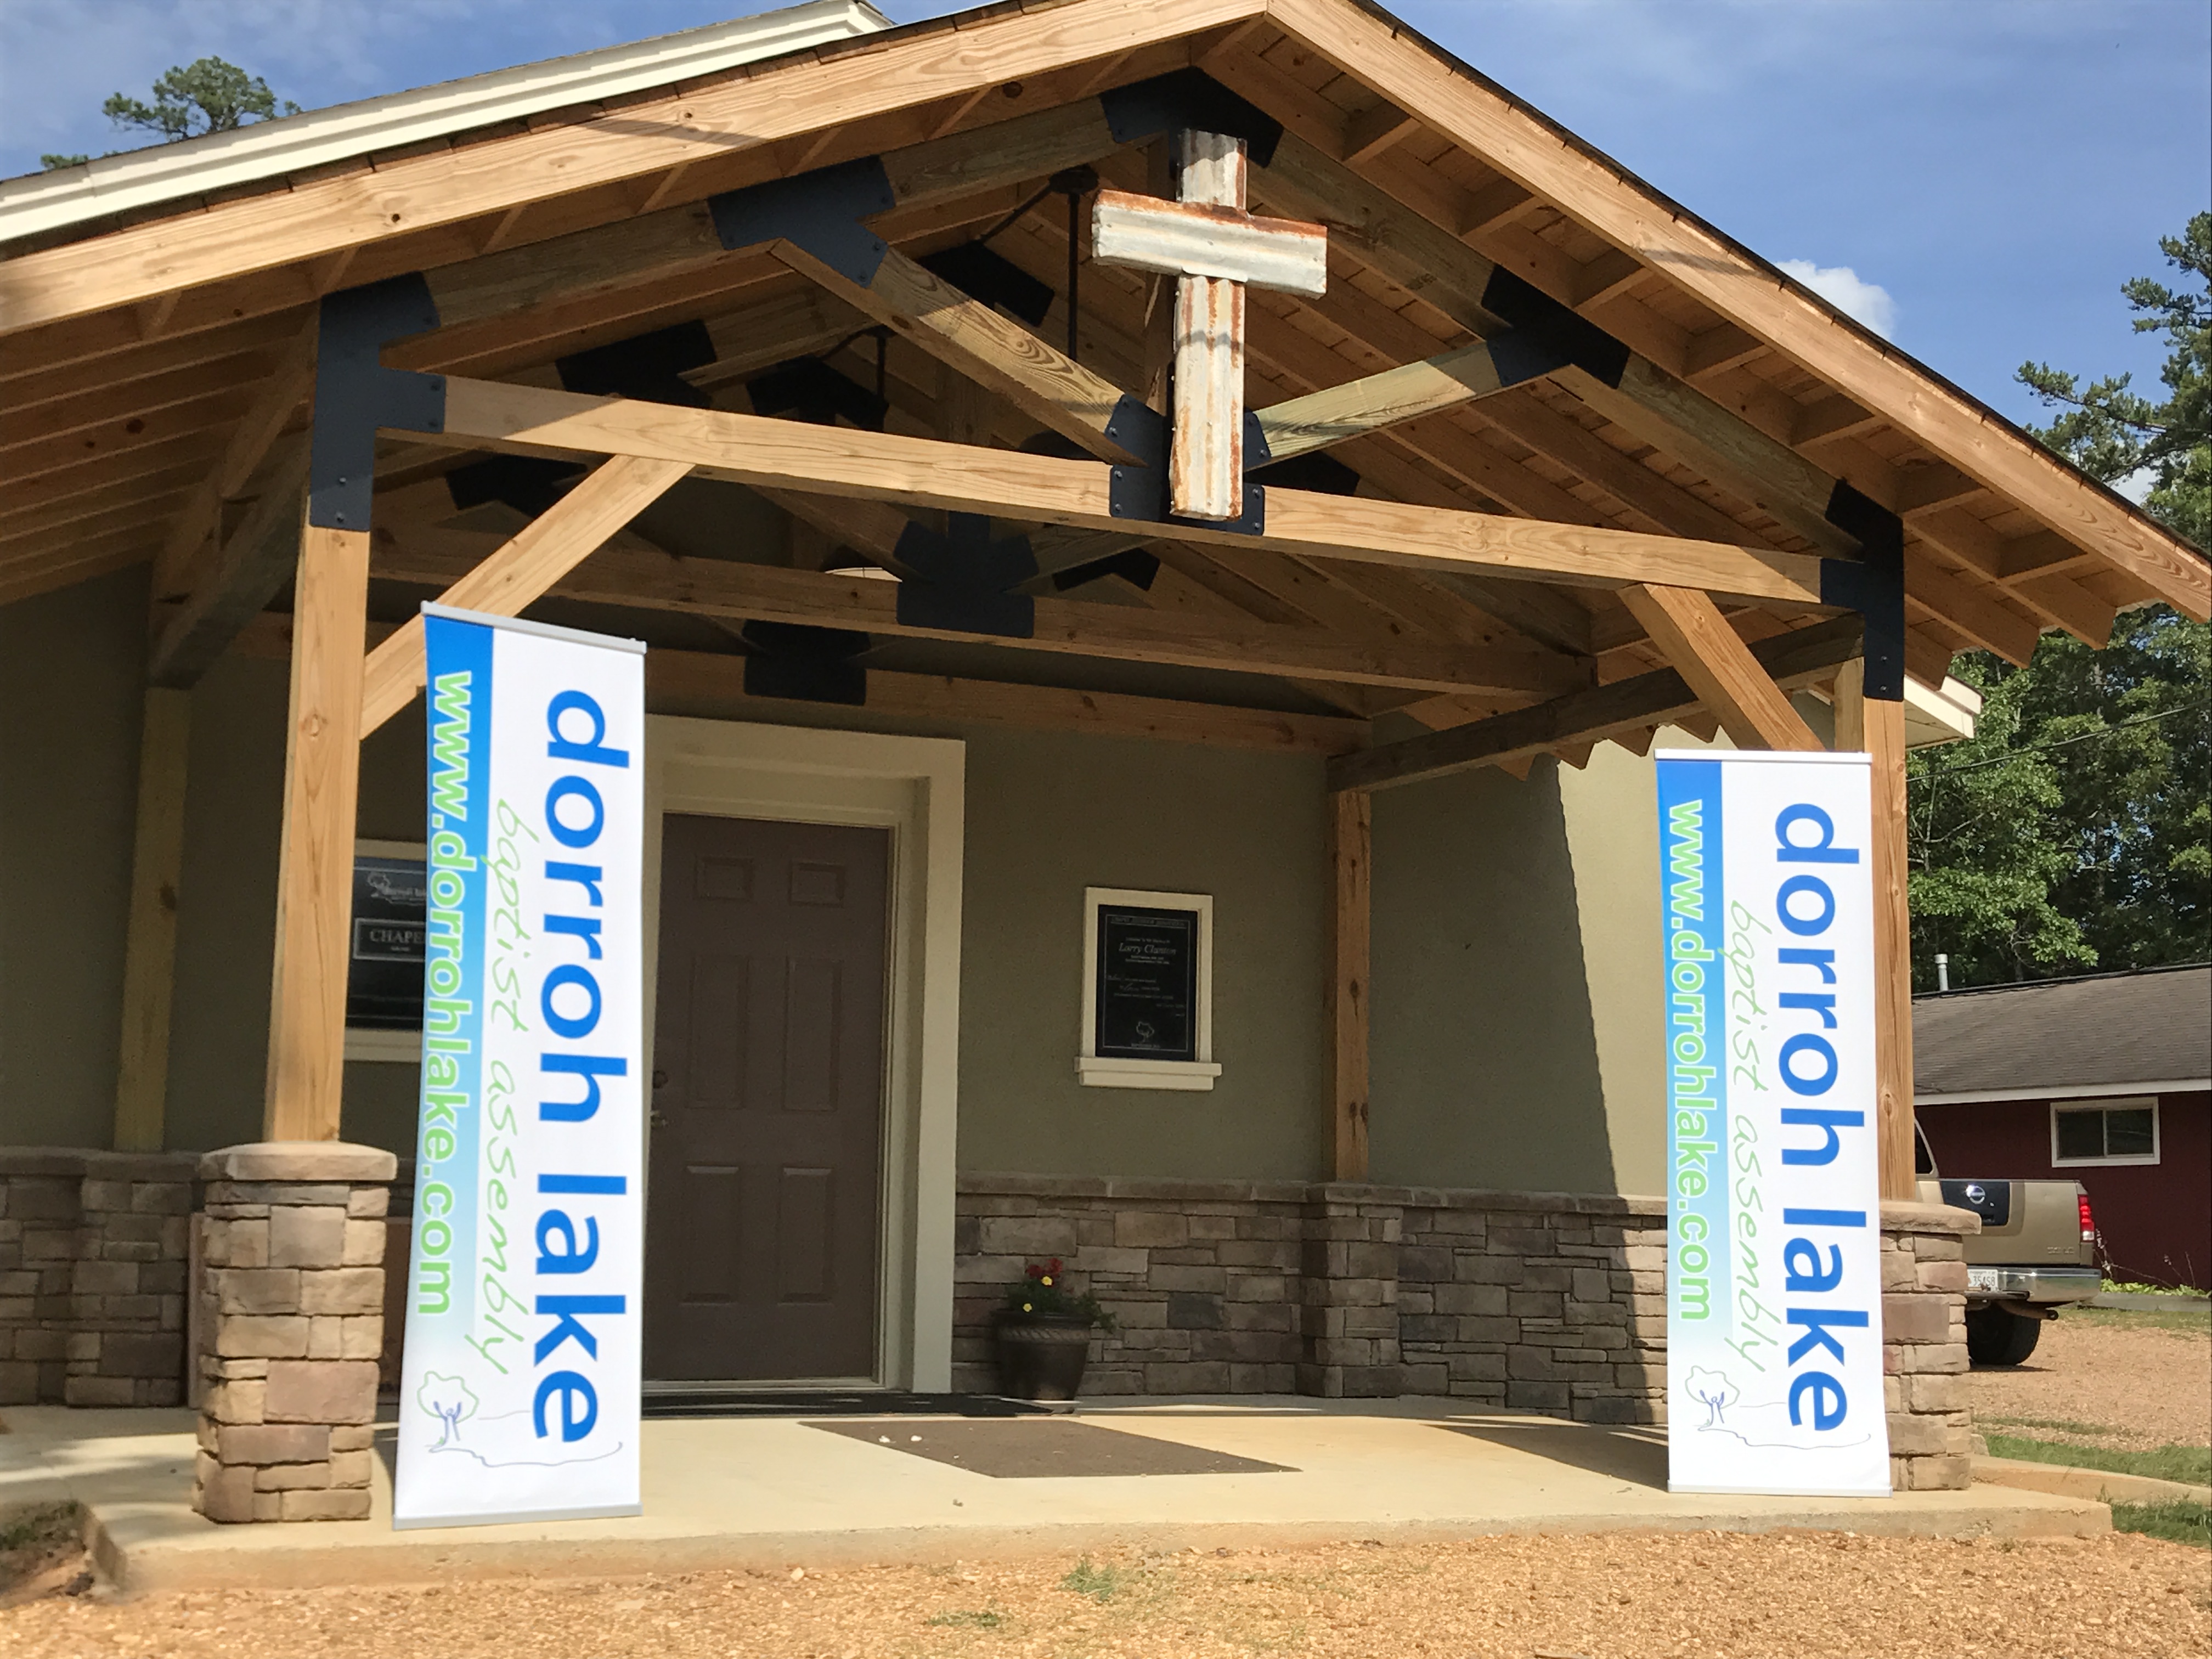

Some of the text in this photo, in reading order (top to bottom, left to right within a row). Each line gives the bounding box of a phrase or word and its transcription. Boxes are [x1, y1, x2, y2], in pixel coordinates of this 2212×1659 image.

[369, 928, 424, 944] CHAPE
[417, 672, 475, 1315] www.dorrohlake.com
[464, 798, 540, 1375] baptist assembly
[534, 690, 629, 1442] dorroh lake
[1670, 800, 1717, 1321] www.dorrohlake.com
[1717, 900, 1781, 1373] baptist assembly
[1775, 803, 1869, 1430] dorroh lake
